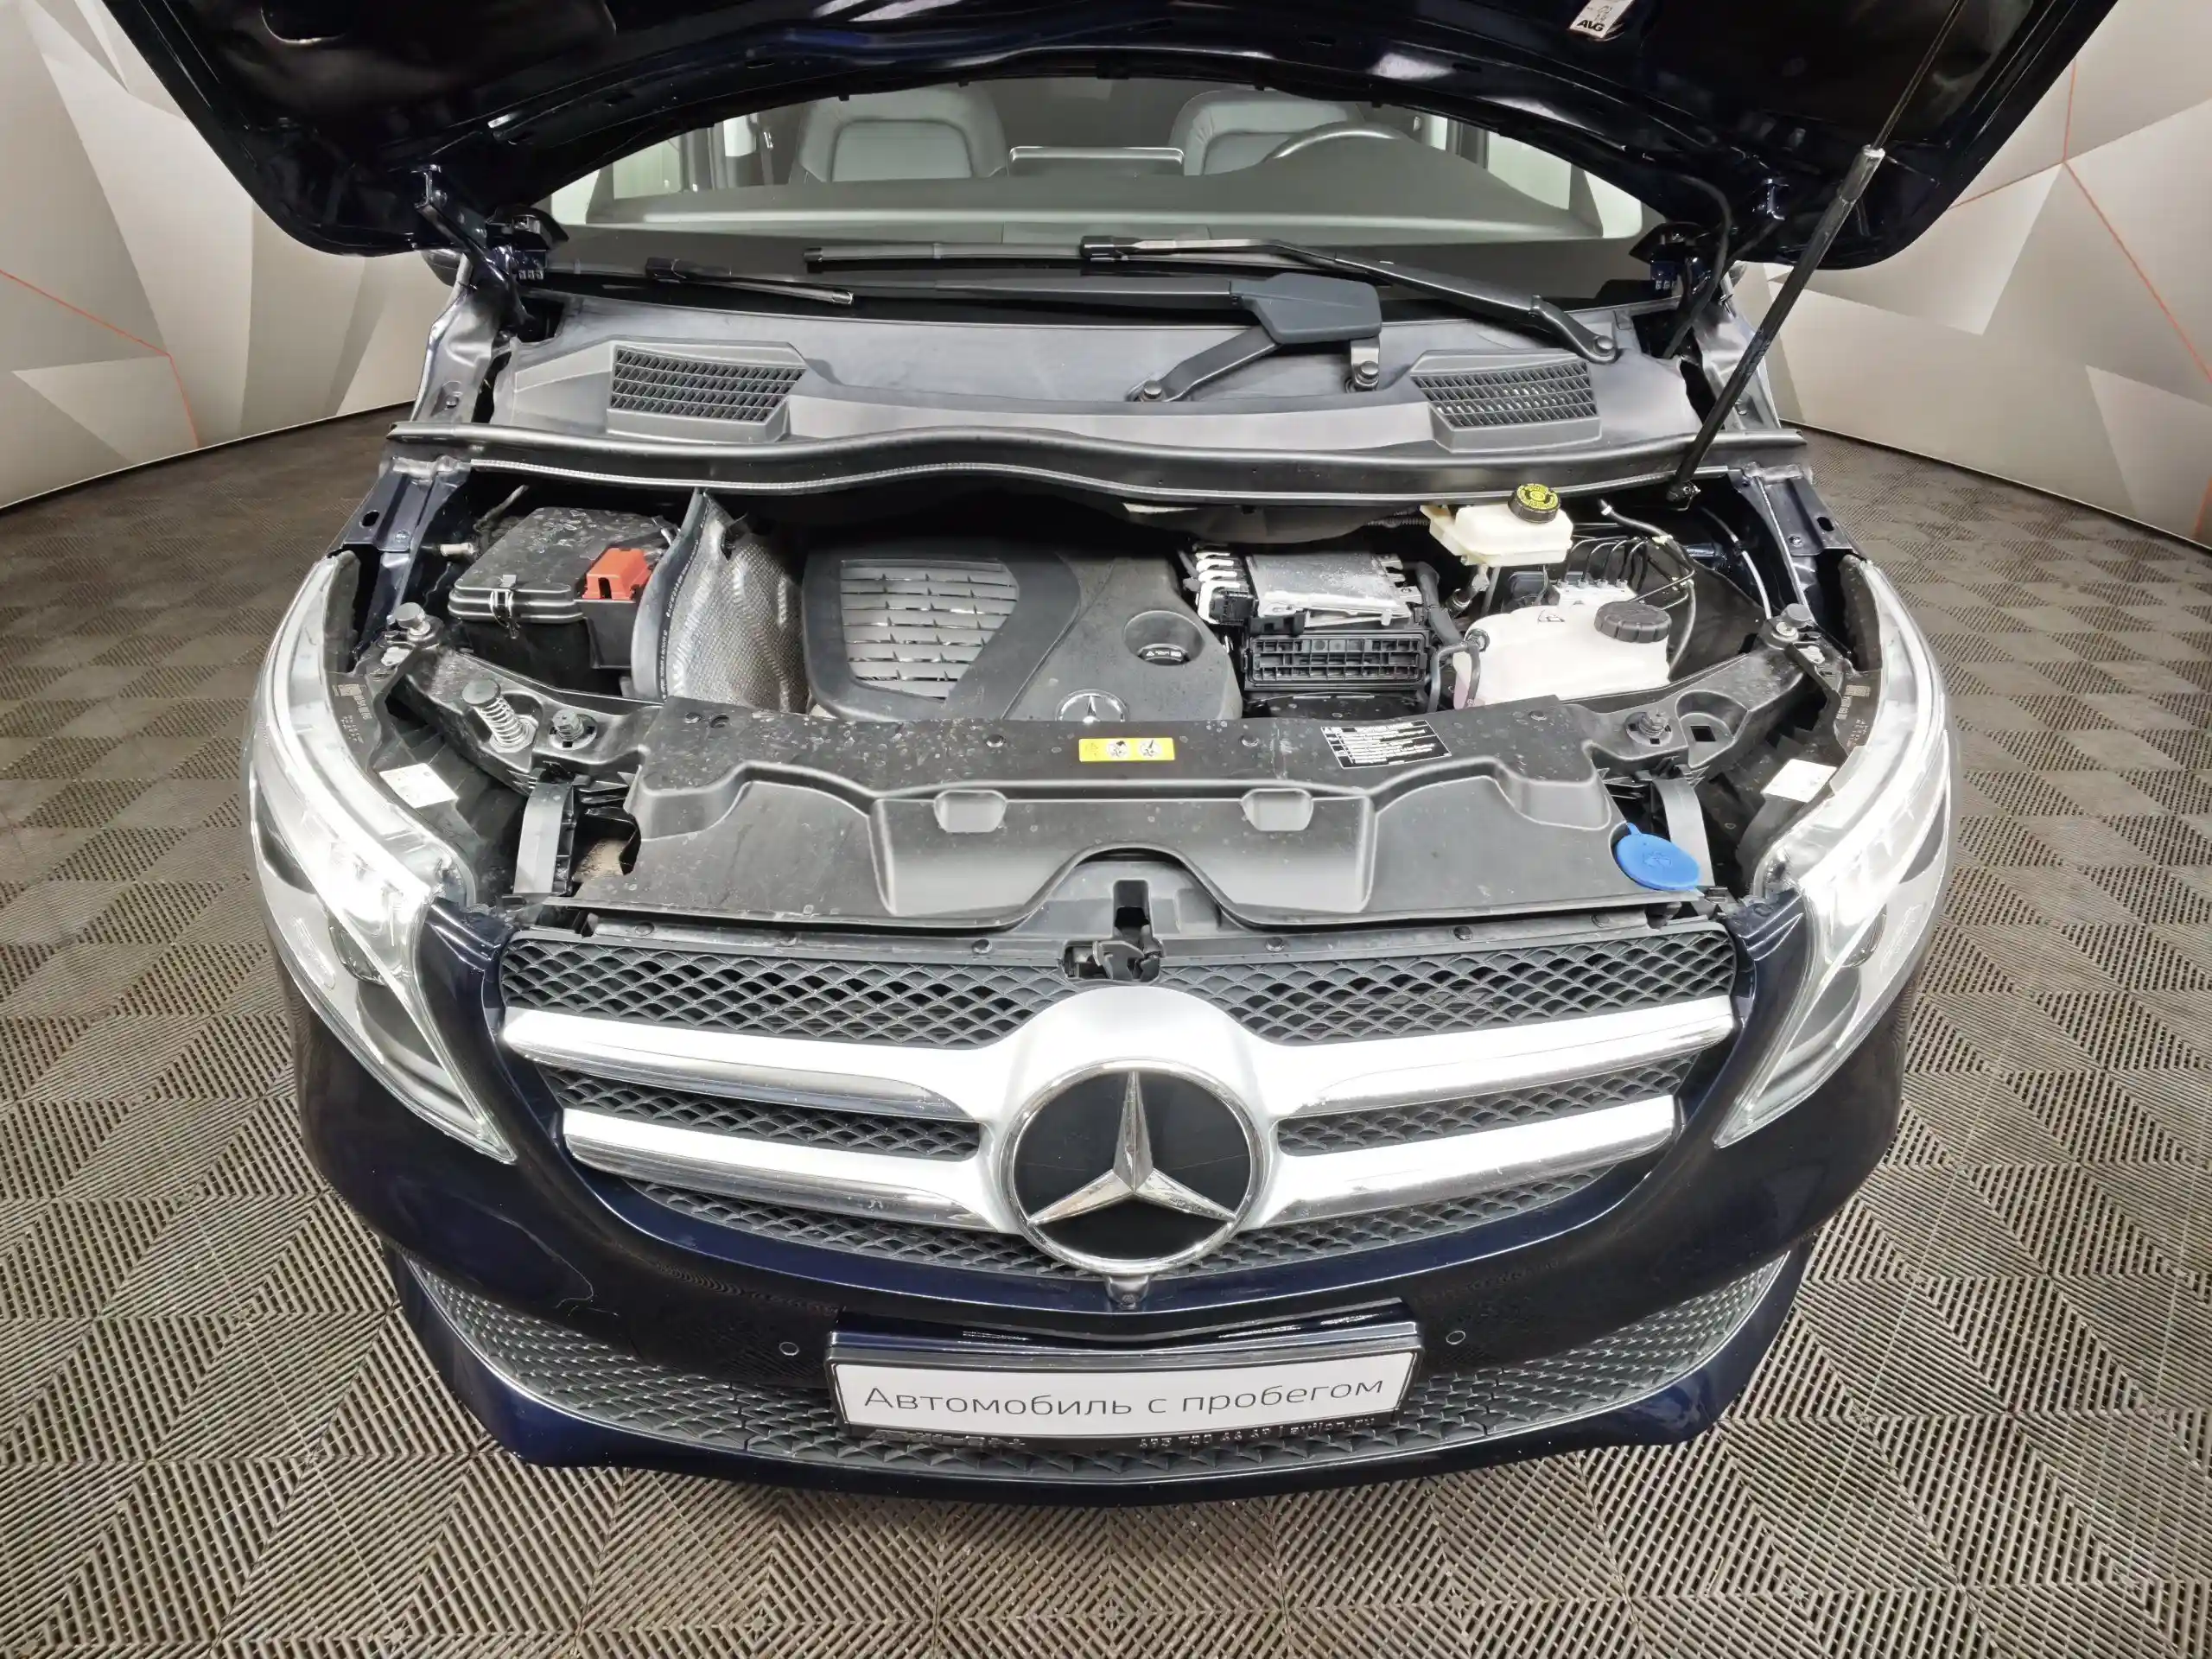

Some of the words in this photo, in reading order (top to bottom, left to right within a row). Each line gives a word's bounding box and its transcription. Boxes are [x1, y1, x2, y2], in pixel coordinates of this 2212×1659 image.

[864, 1387, 1132, 1415] Автомобиль
[1147, 1398, 1167, 1414] с
[1182, 1380, 1383, 1414] пробегом
